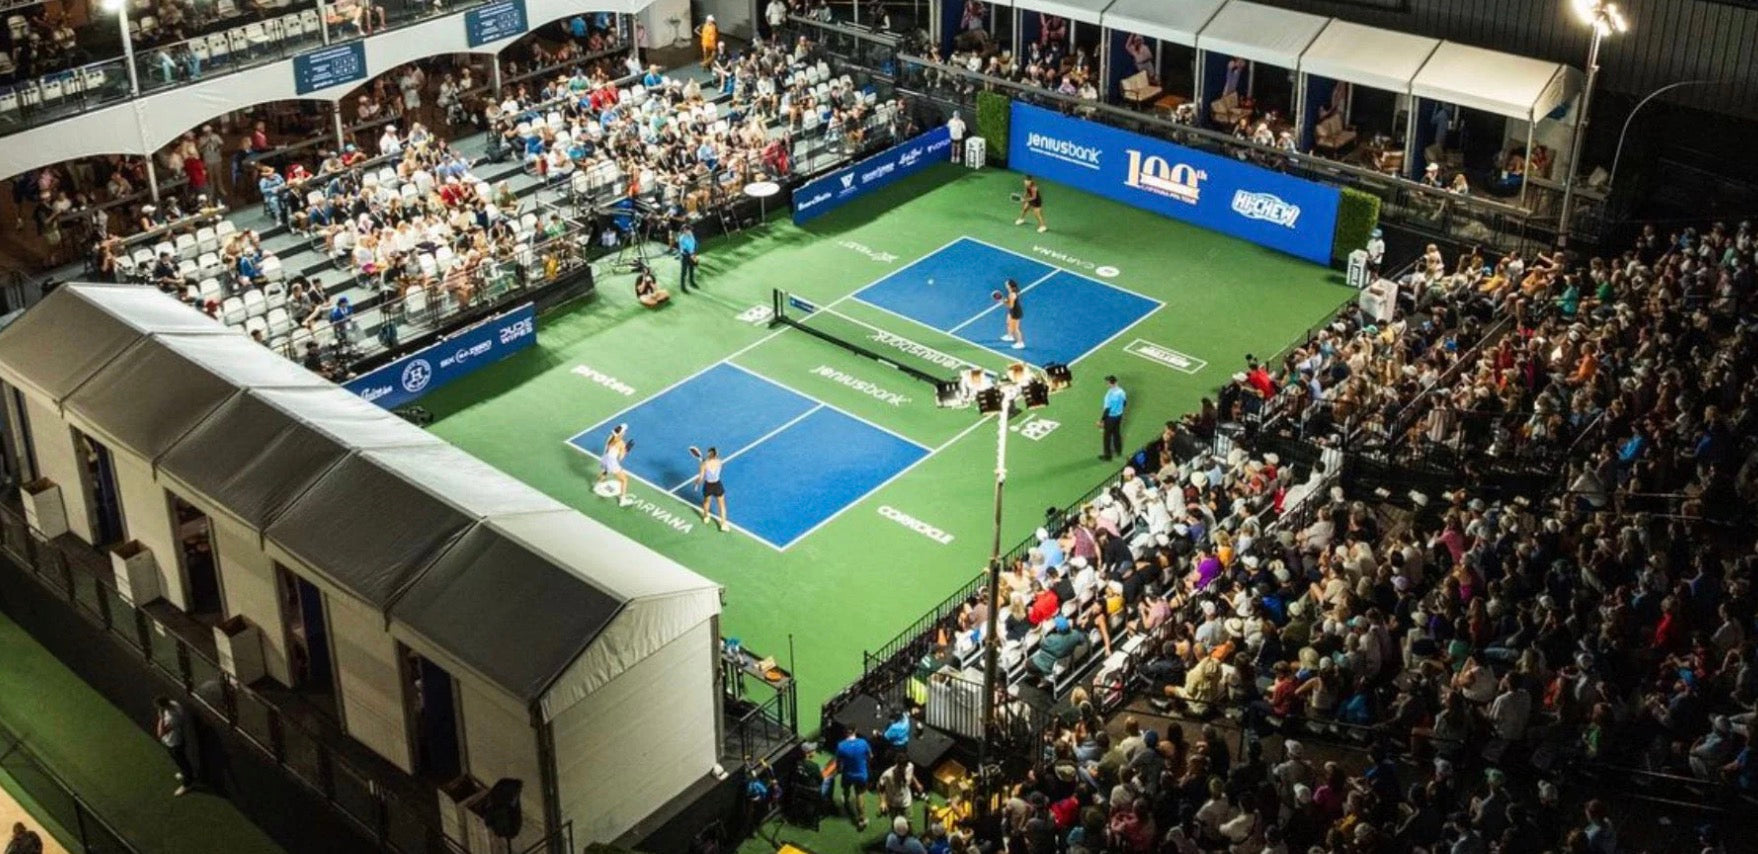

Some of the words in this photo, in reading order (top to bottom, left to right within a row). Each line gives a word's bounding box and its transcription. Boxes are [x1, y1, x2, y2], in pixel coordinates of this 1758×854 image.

[1027, 132, 1102, 164] jeniusbank
[1033, 245, 1095, 269] CARVANA
[500, 316, 532, 338] DUDE
[501, 326, 533, 344] WIPES
[810, 364, 905, 407] jeniusbank
[623, 493, 694, 534] CARVANA
